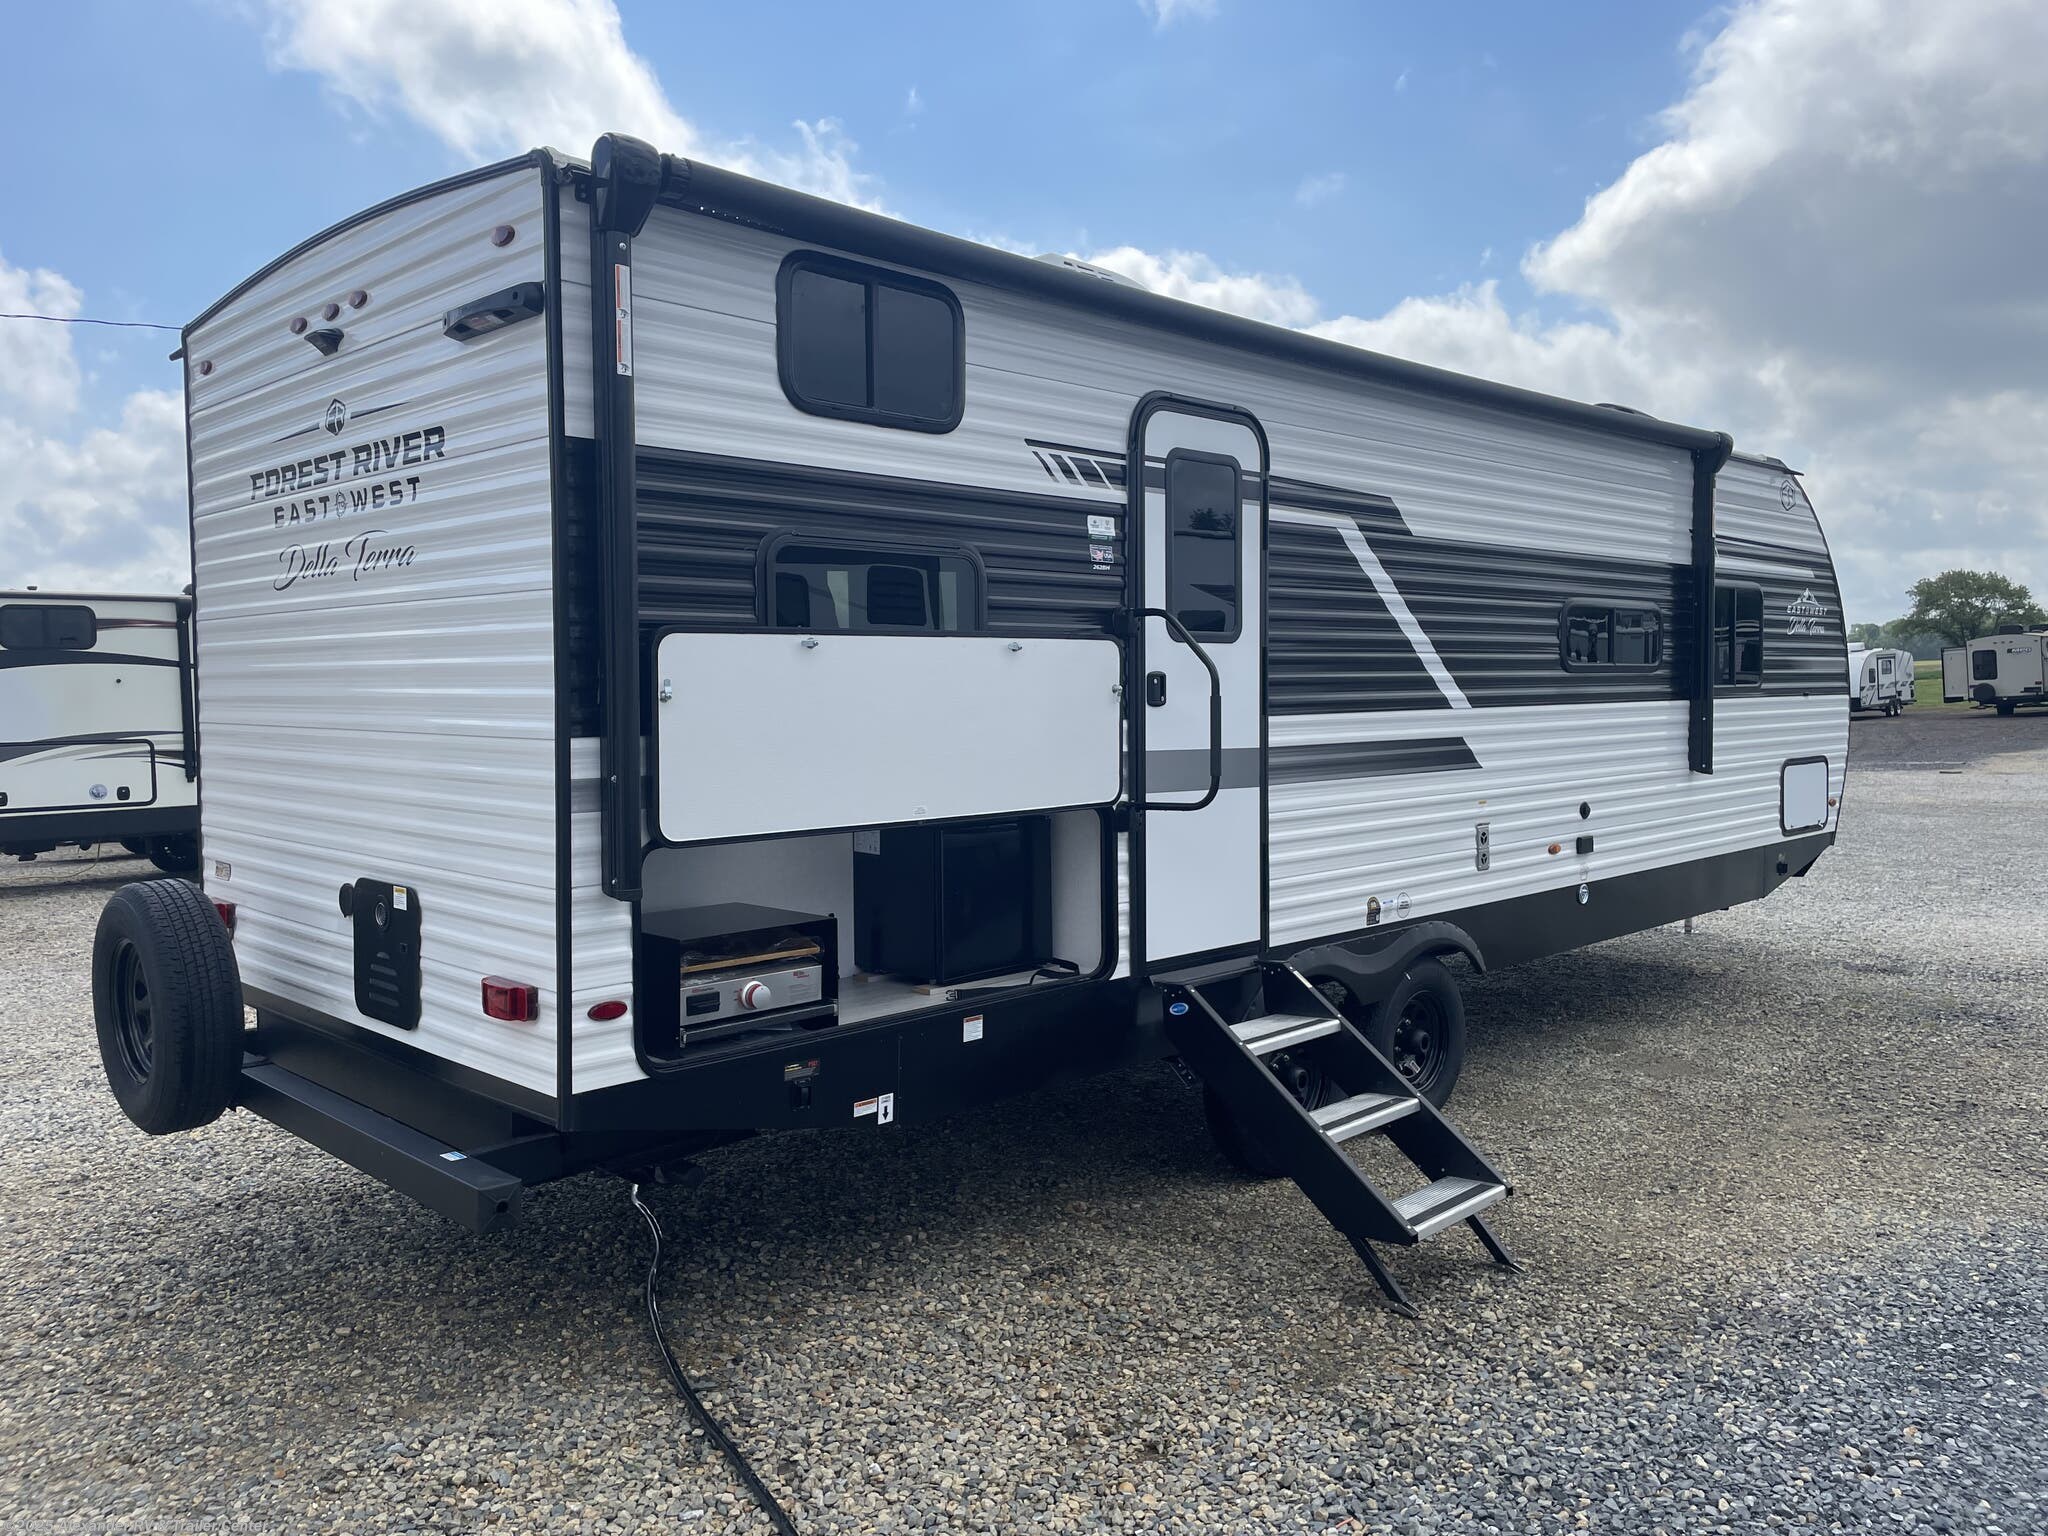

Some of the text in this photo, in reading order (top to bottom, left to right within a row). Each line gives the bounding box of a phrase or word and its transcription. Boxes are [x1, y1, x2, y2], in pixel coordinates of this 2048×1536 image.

[250, 425, 446, 500] FOREST RIVER
[273, 496, 330, 529] EAST
[349, 476, 421, 513] WEST
[272, 529, 419, 591] Della Terra
